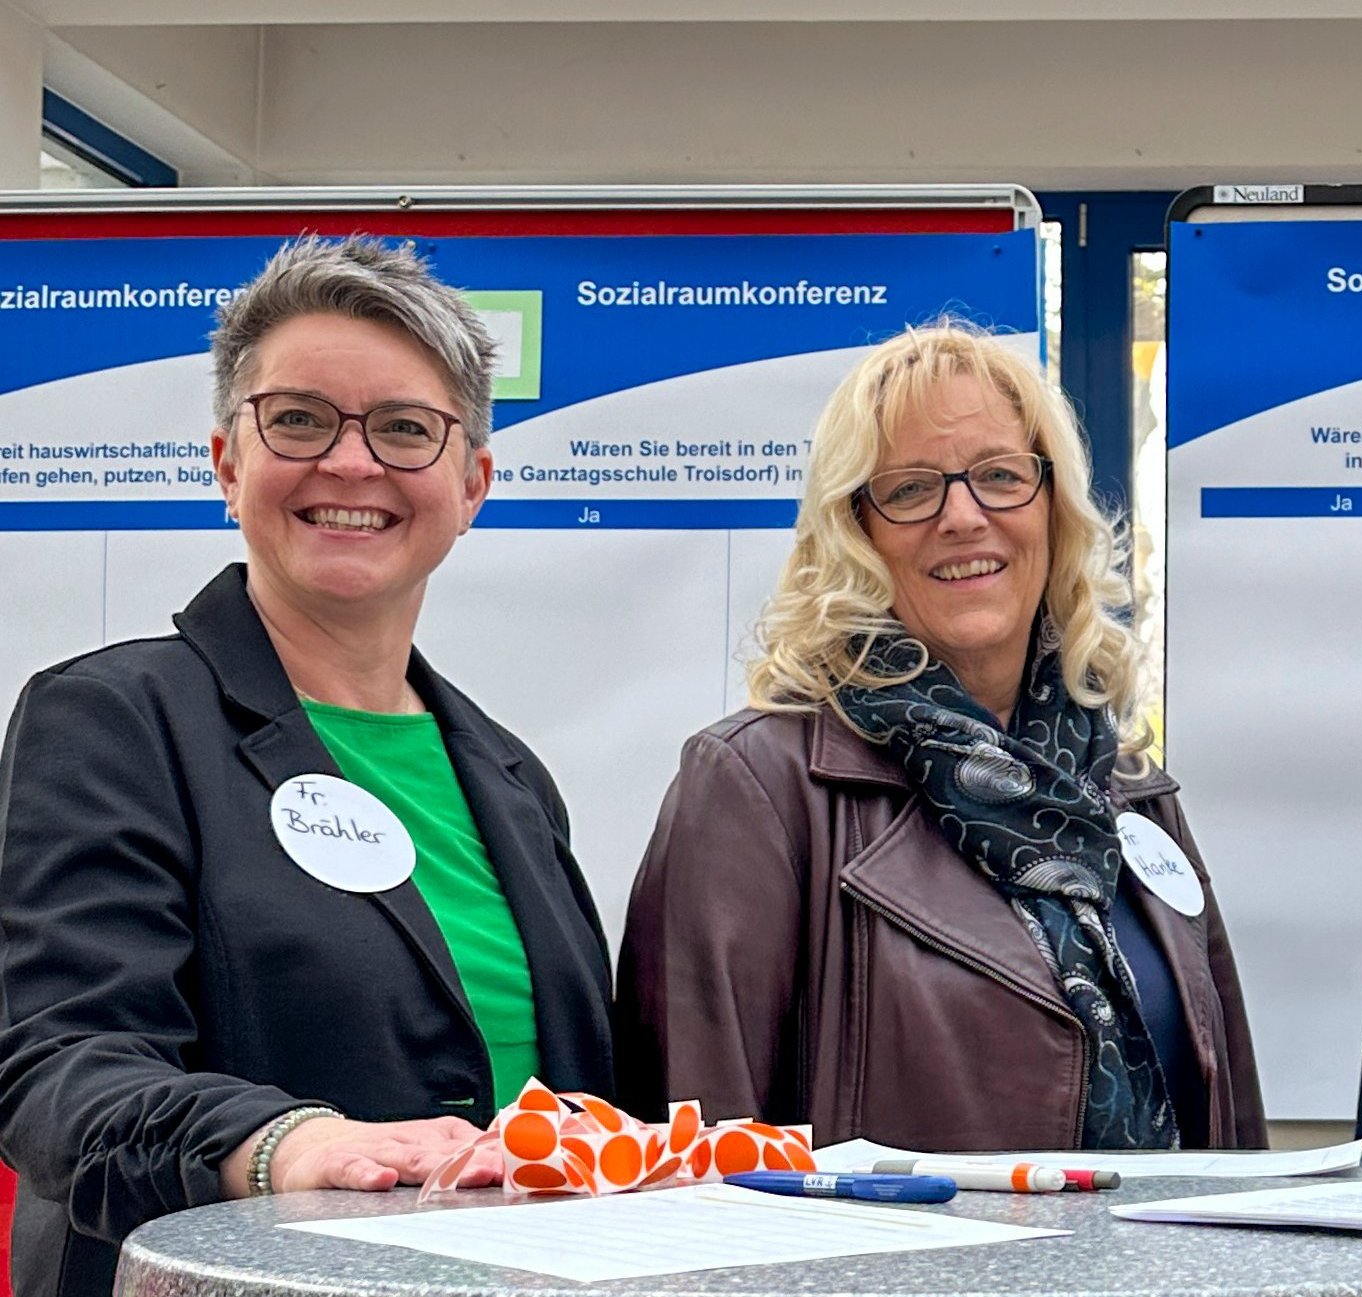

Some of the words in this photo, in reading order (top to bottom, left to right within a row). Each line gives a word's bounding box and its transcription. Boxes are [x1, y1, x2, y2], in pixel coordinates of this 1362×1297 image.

[1233, 186, 1299, 203] Neuland
[577, 280, 887, 307] Sozialraumkonferenz
[29, 441, 210, 459] hauswirtschaftliche
[570, 440, 633, 457] Wären
[640, 440, 670, 457] Sie
[676, 439, 732, 457] bereit
[738, 440, 755, 457] in
[762, 440, 797, 457] den
[1345, 453, 1362, 469] in
[36, 467, 98, 488] gehen,
[104, 467, 172, 487] putzen,
[520, 465, 678, 486] Ganztagsschule
[684, 464, 780, 486] Troisdorf)
[786, 465, 803, 482] in
[1330, 494, 1353, 512] Ja
[578, 506, 601, 524] Ja
[281, 808, 387, 843] Brähler
